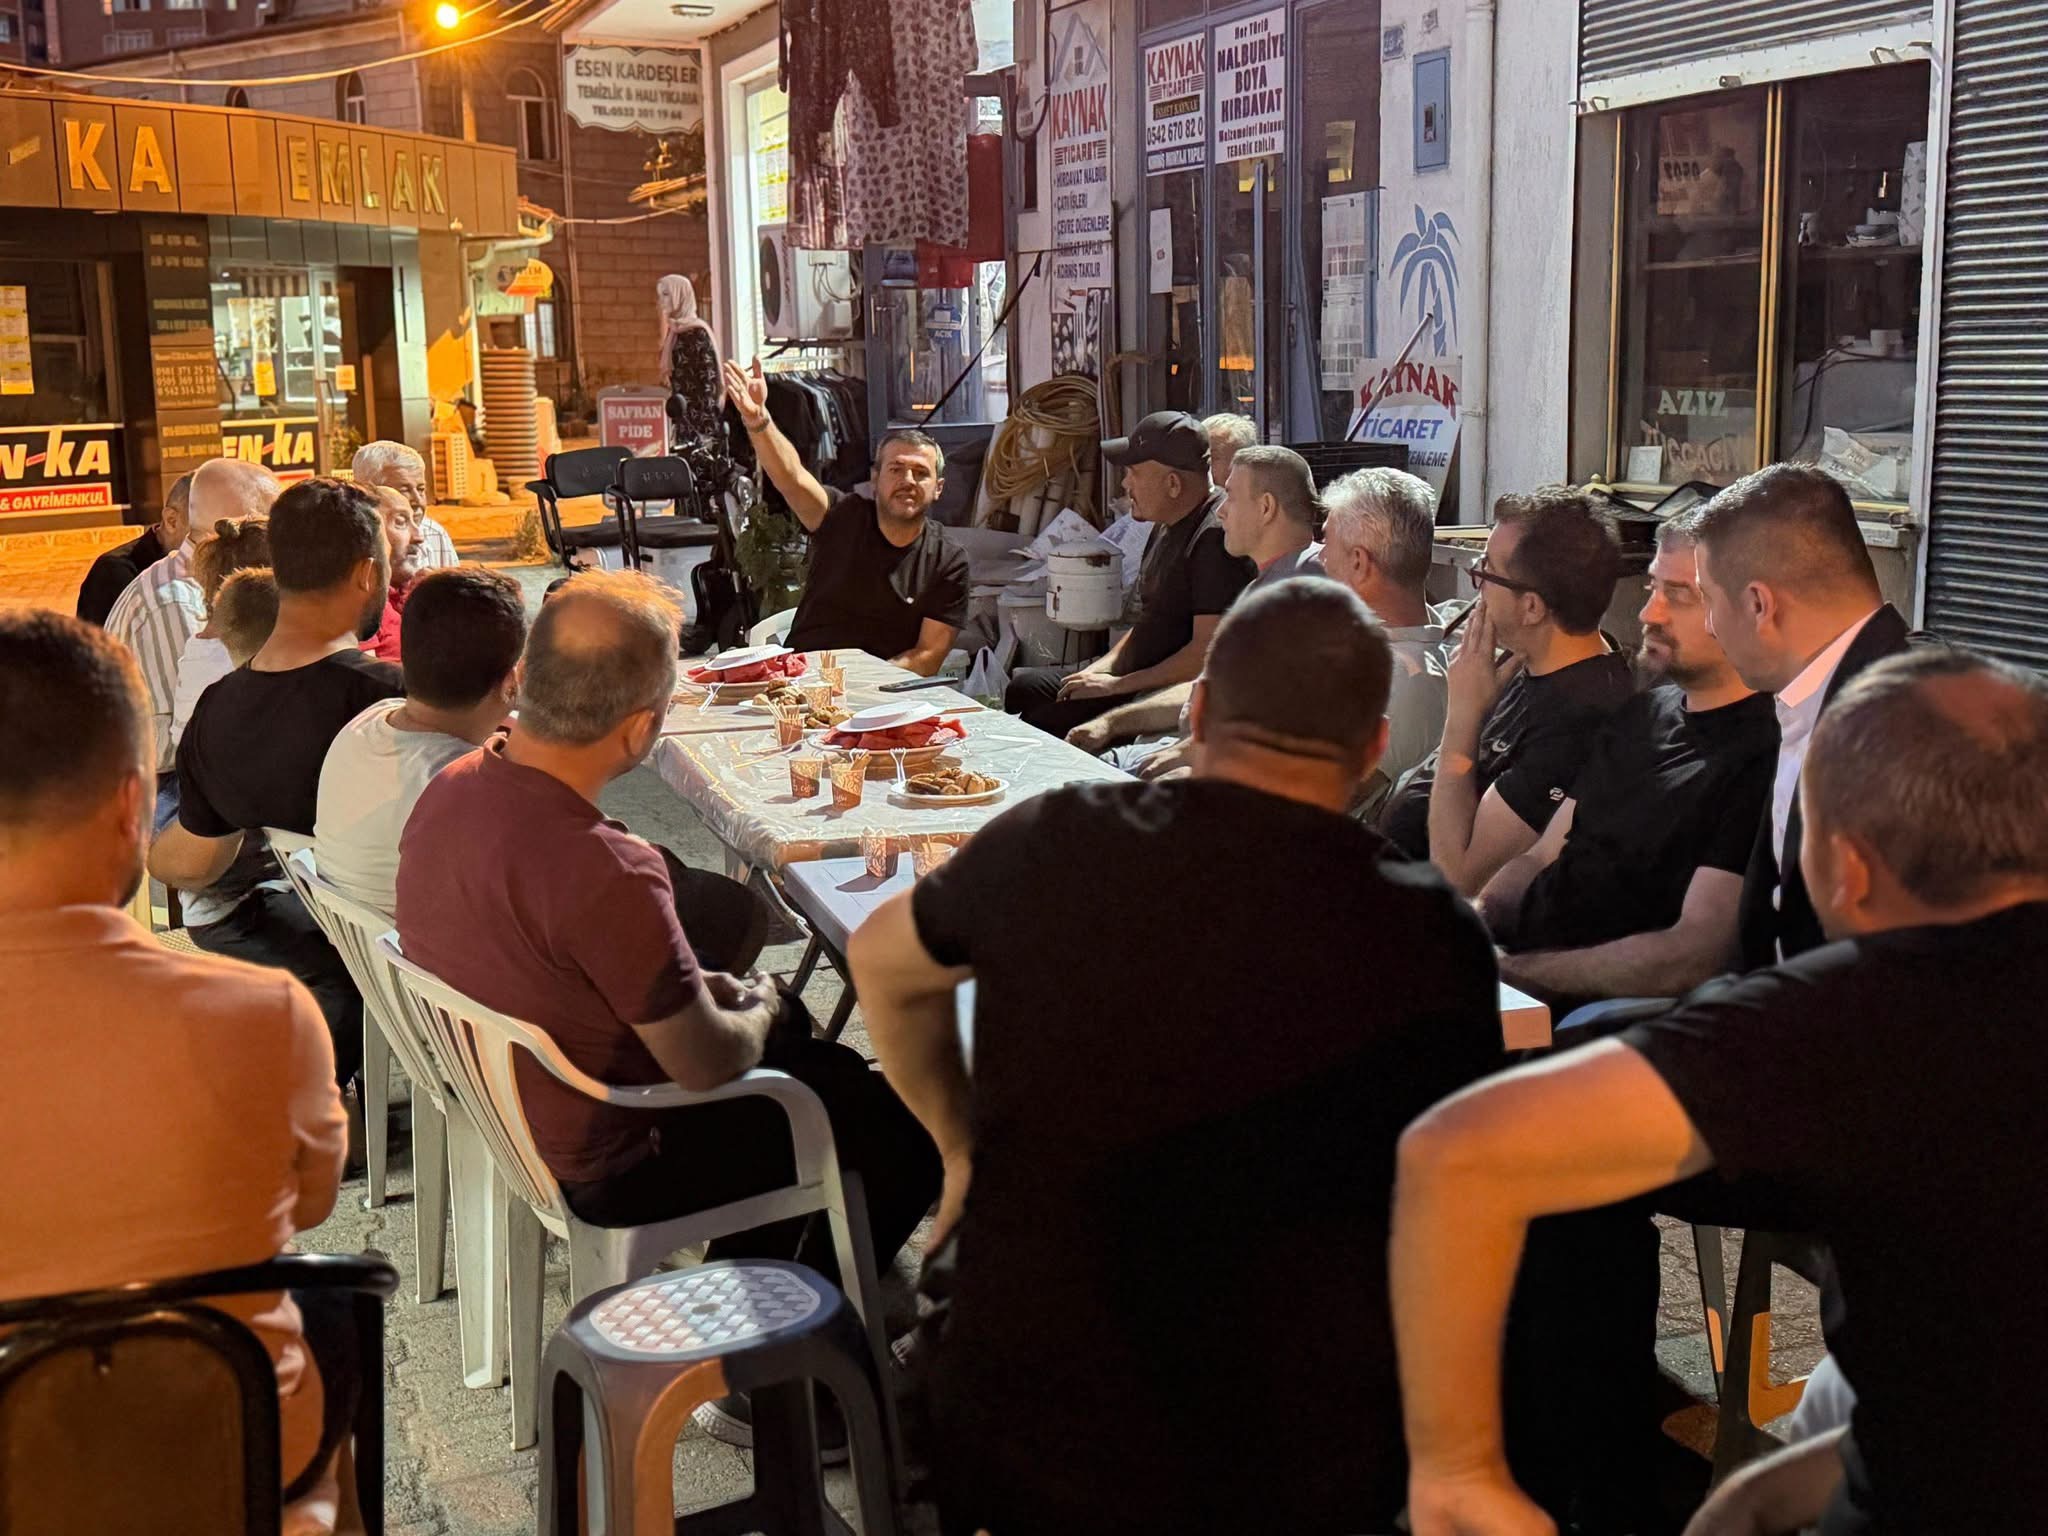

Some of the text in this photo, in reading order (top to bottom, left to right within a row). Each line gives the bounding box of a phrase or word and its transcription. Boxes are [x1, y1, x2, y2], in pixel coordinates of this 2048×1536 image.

[575, 60, 698, 88] ESEN KARDEŞLER
[1147, 38, 1205, 86] KAYNAK
[577, 82, 624, 100] TEMİZLİK
[635, 89, 657, 103] HALI
[659, 90, 698, 105] YIKAMA
[1235, 65, 1268, 94] BOYA
[1053, 83, 1107, 140] KAYNAK
[1221, 88, 1283, 123] HIRDAVAT
[1147, 124, 1166, 146] 0542
[1167, 121, 1183, 141] 670
[1185, 118, 1195, 138] 82
[287, 136, 445, 215] EMLAK
[1057, 168, 1082, 187] HIRDAVAT
[607, 405, 662, 419] SAFRAN
[1362, 413, 1443, 439] TİCARET
[618, 422, 653, 438] PİDE
[12, 492, 105, 510] GAYRİMENKUL
